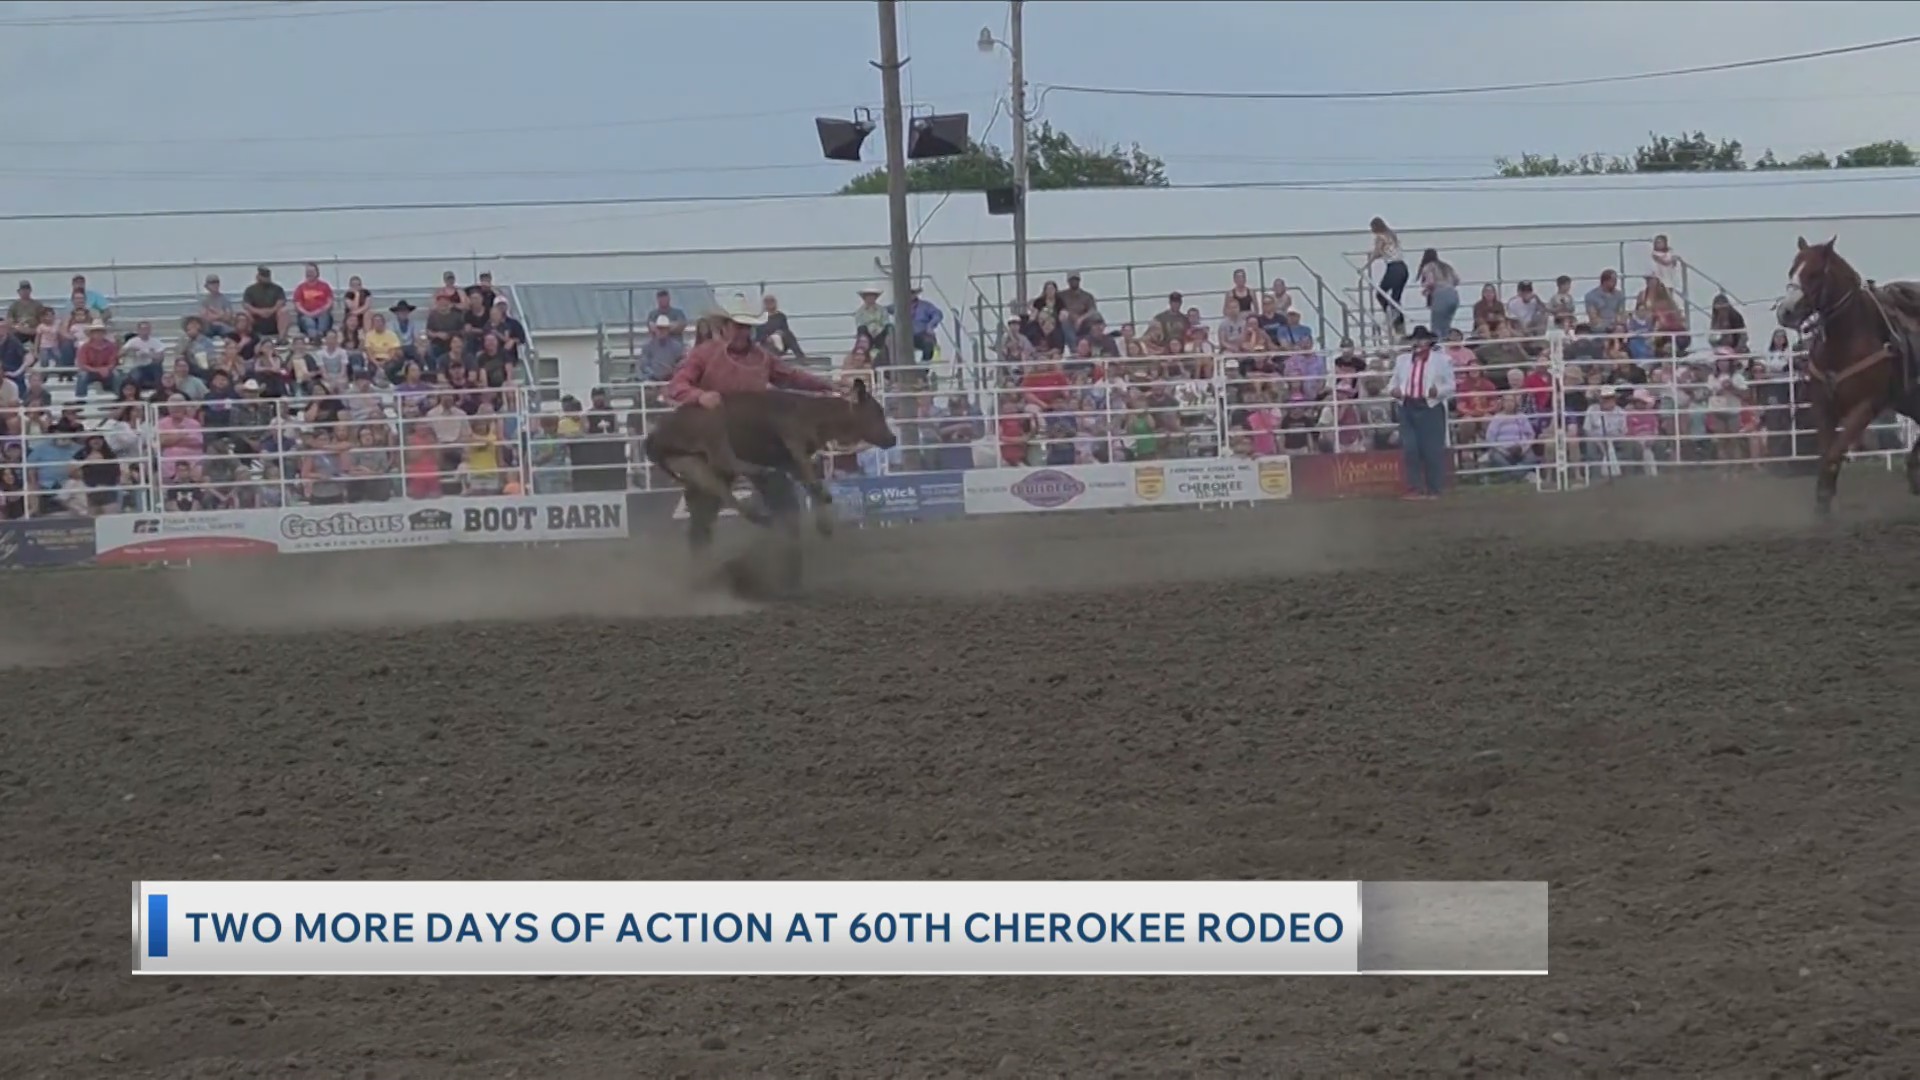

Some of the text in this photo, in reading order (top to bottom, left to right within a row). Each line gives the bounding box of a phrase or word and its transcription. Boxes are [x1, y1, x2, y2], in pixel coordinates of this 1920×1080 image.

[882, 486, 917, 499] Wick
[1178, 481, 1243, 493] CHEROKEE
[280, 512, 404, 539] Gasthaus
[463, 504, 622, 532] BOOT BARN
